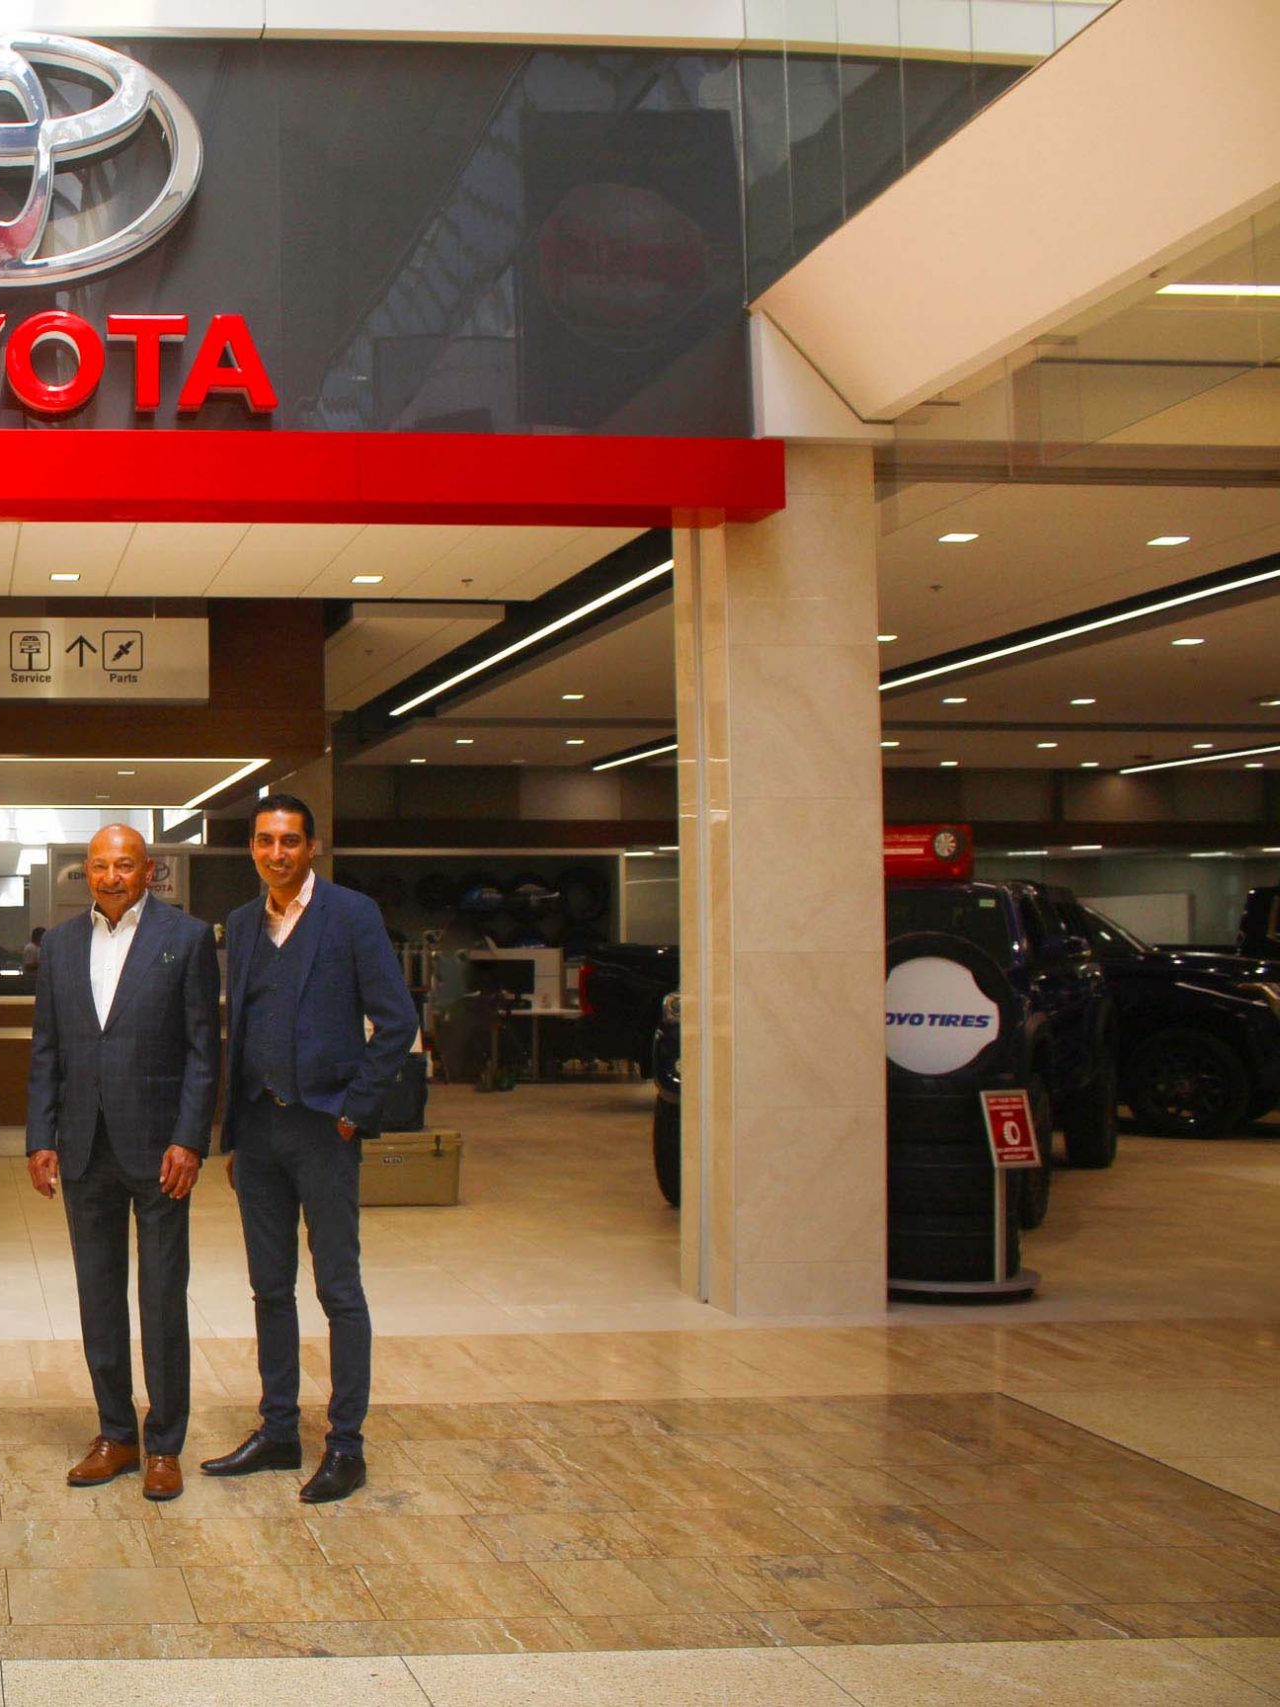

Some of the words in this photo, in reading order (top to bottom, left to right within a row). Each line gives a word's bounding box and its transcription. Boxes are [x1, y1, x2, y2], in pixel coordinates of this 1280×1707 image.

[11, 673, 52, 684] Service
[109, 673, 138, 684] Parts
[927, 1013, 992, 1029] TIRES
